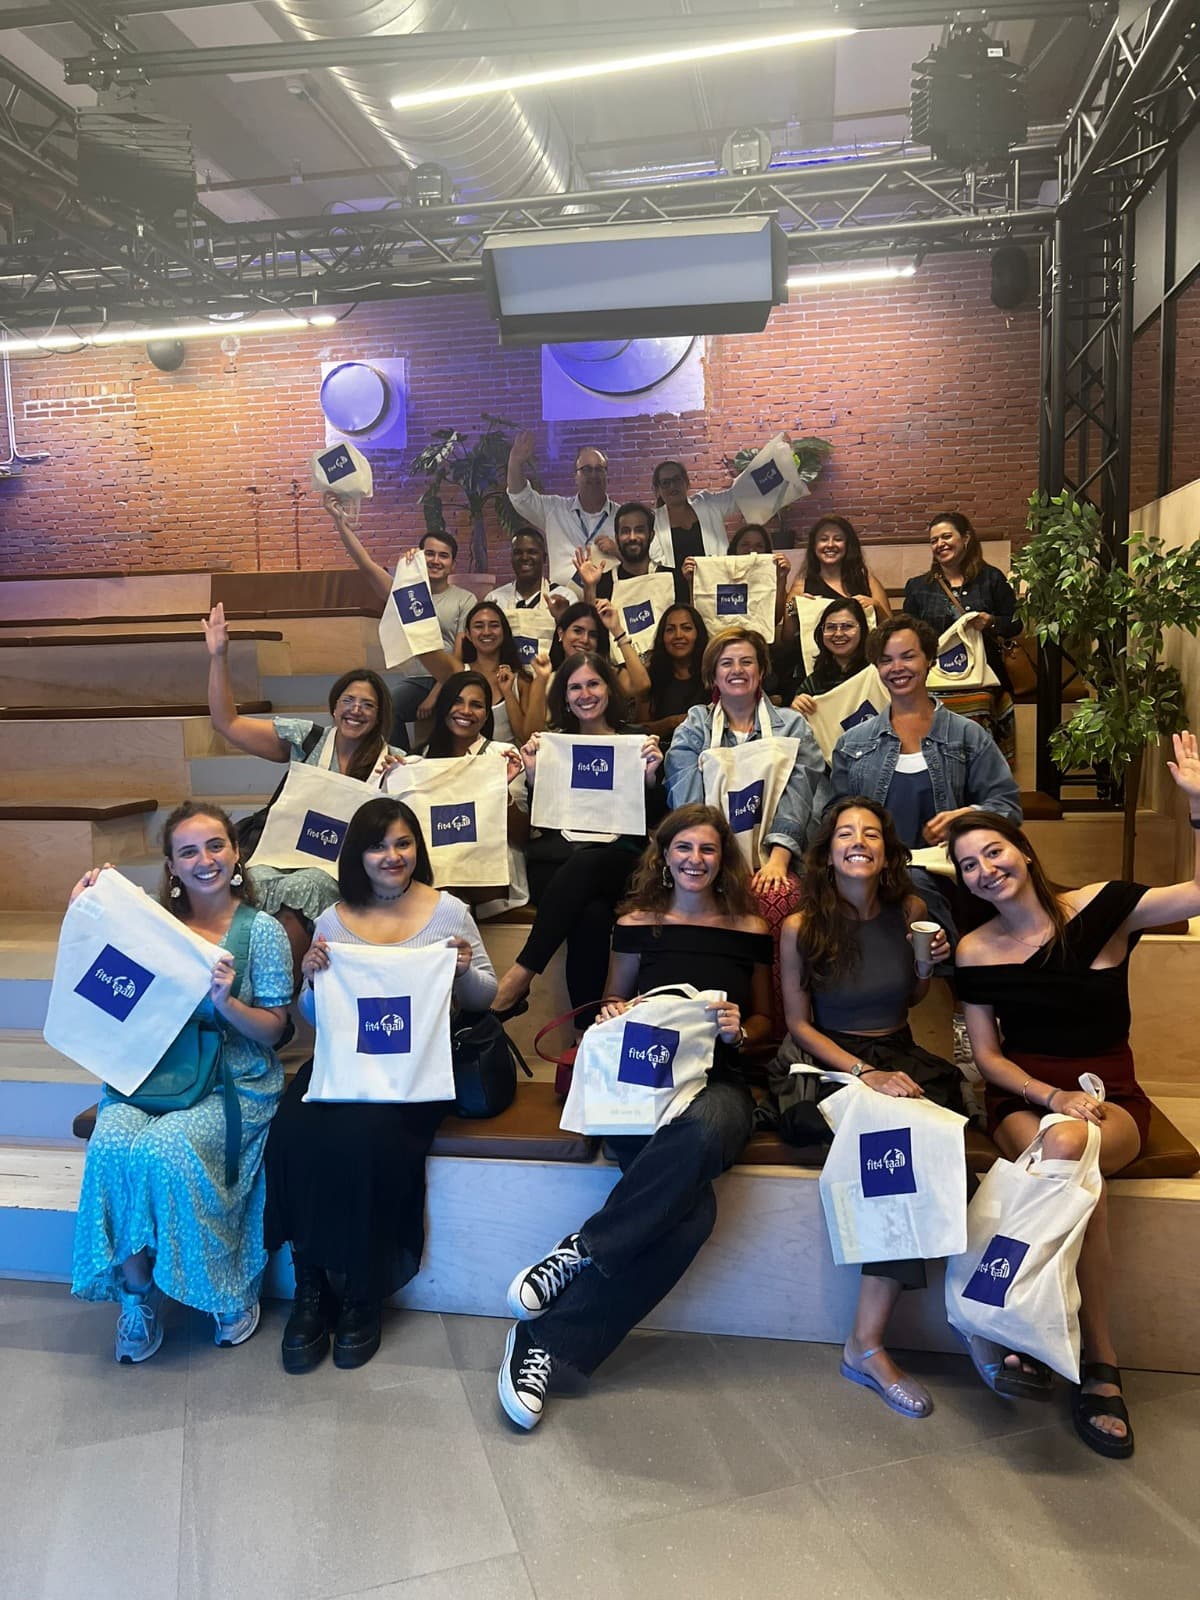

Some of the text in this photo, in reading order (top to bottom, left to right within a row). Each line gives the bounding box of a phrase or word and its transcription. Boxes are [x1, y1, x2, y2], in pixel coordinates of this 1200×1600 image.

[94, 968, 136, 998] fit4 taal
[365, 1015, 404, 1032] fit4 taal
[628, 1048, 646, 1061] fit4
[867, 1150, 905, 1170] fit4 taal
